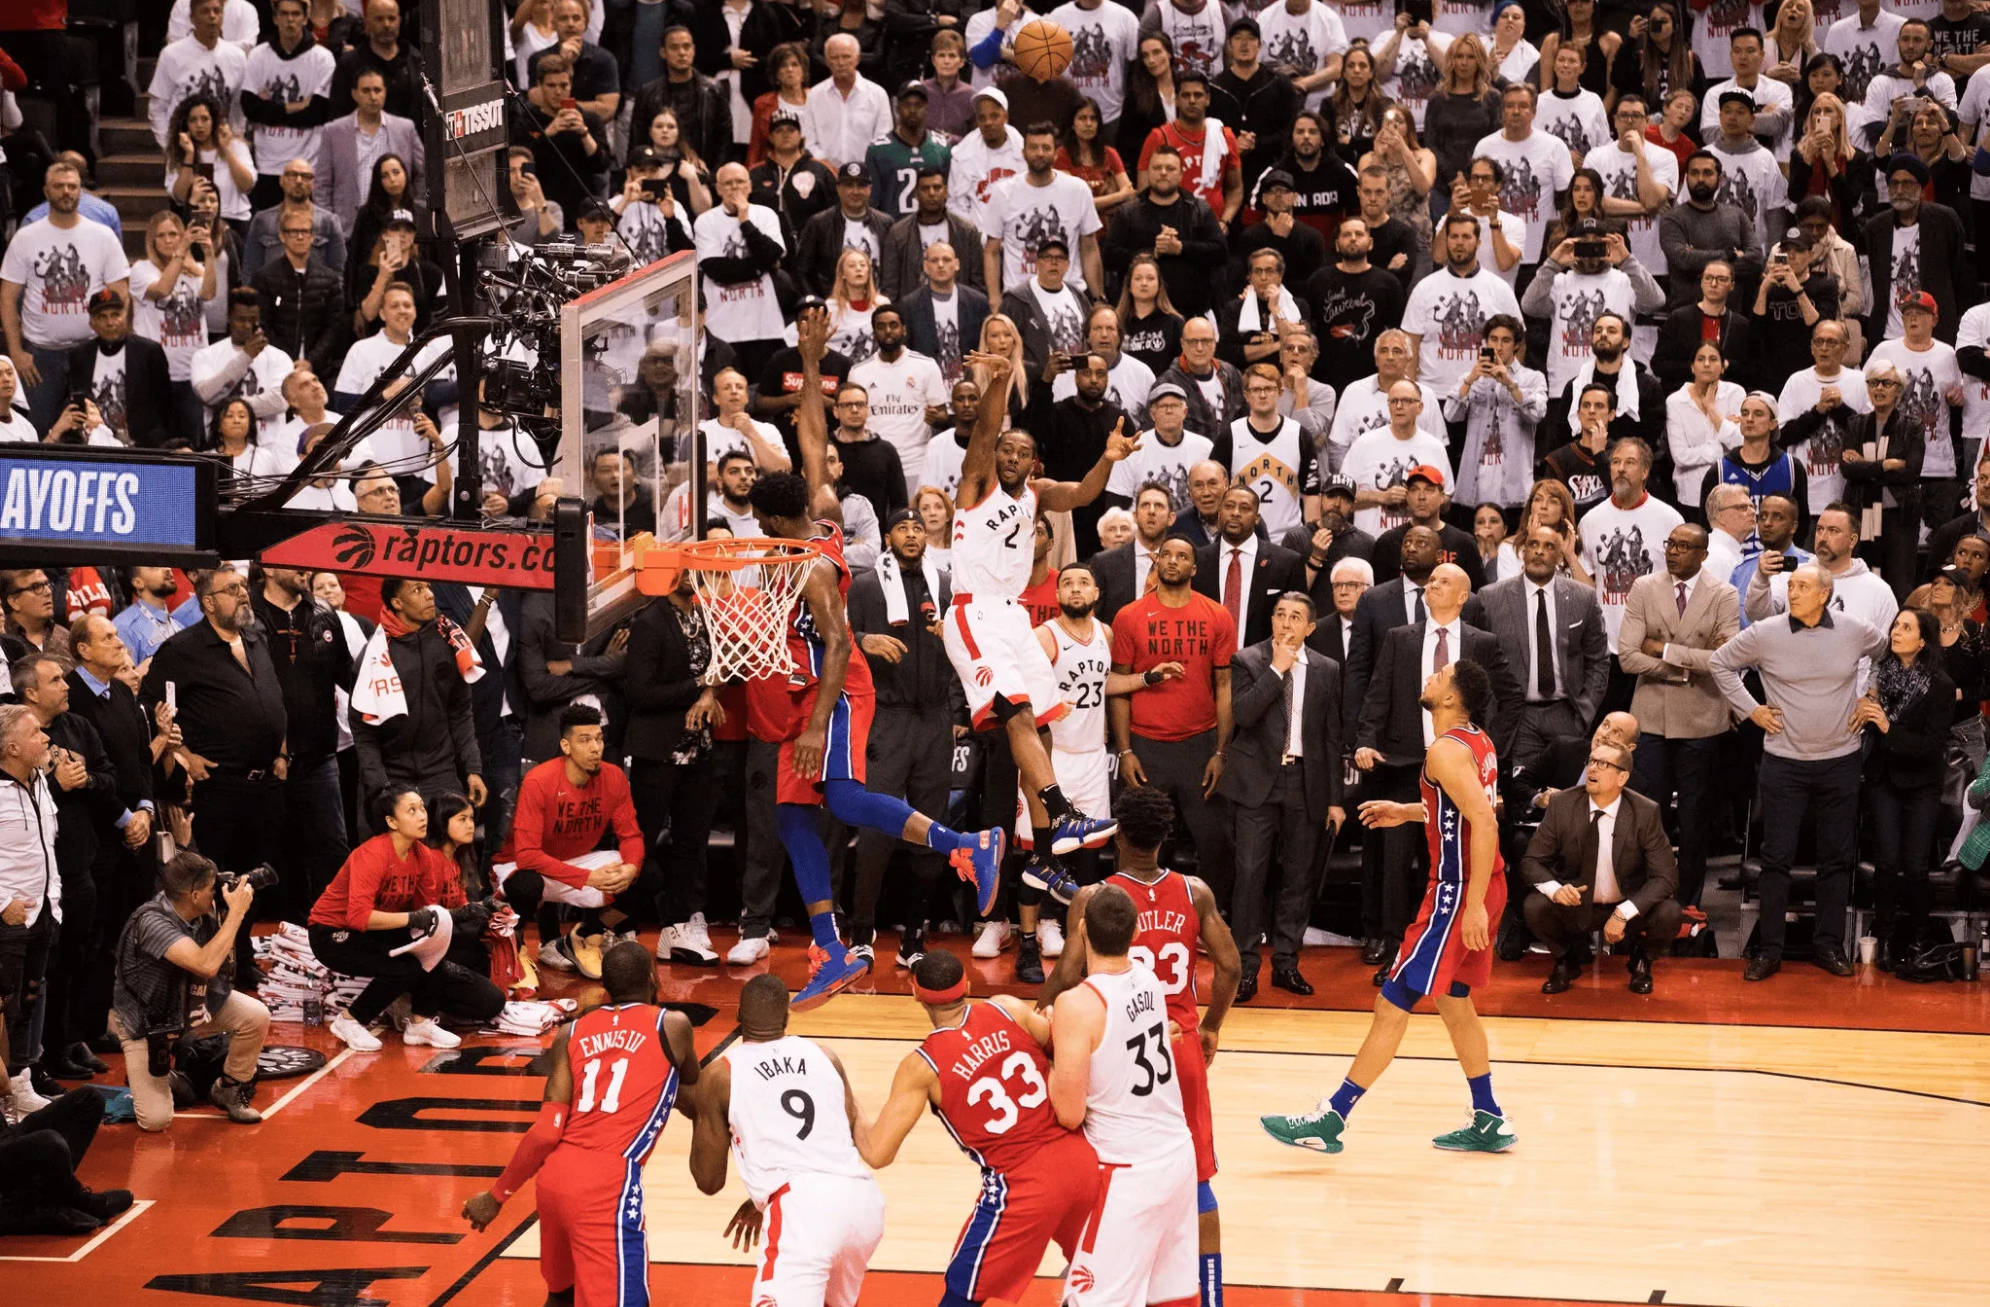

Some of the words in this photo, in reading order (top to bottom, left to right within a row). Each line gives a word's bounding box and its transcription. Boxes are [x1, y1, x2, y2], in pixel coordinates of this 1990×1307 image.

[1934, 30, 1950, 43] WE
[1955, 29, 1980, 43] THE
[462, 98, 505, 136] TISSOT
[1628, 217, 1652, 232] RTH
[1562, 345, 1591, 357] NOR
[870, 403, 919, 417] Emirates
[885, 394, 901, 404] Fly
[1238, 458, 1294, 486] NORTH
[1807, 463, 1838, 476] NOR
[0, 468, 139, 534] AYOFFS
[1260, 480, 1274, 504] 2
[1004, 523, 1020, 549] 2
[383, 533, 556, 574] raptors.co
[1602, 592, 1628, 605] NOR
[1148, 620, 1167, 636] WE
[1175, 620, 1207, 637] THE
[1148, 638, 1209, 655] NORTH
[1075, 681, 1103, 708] 23
[558, 801, 575, 818] WE
[579, 797, 602, 815] THE
[554, 816, 603, 834] NORTH
[1137, 910, 1186, 934] UTLER
[1126, 991, 1155, 1022] GASOL
[579, 1029, 627, 1058] ENNIS
[951, 1029, 1010, 1082] HARRIS
[753, 1056, 807, 1082] IBAKA
[1126, 1021, 1172, 1096] 33
[577, 1058, 629, 1113] 11
[967, 1051, 1048, 1134] 33
[780, 1089, 816, 1141] 9
